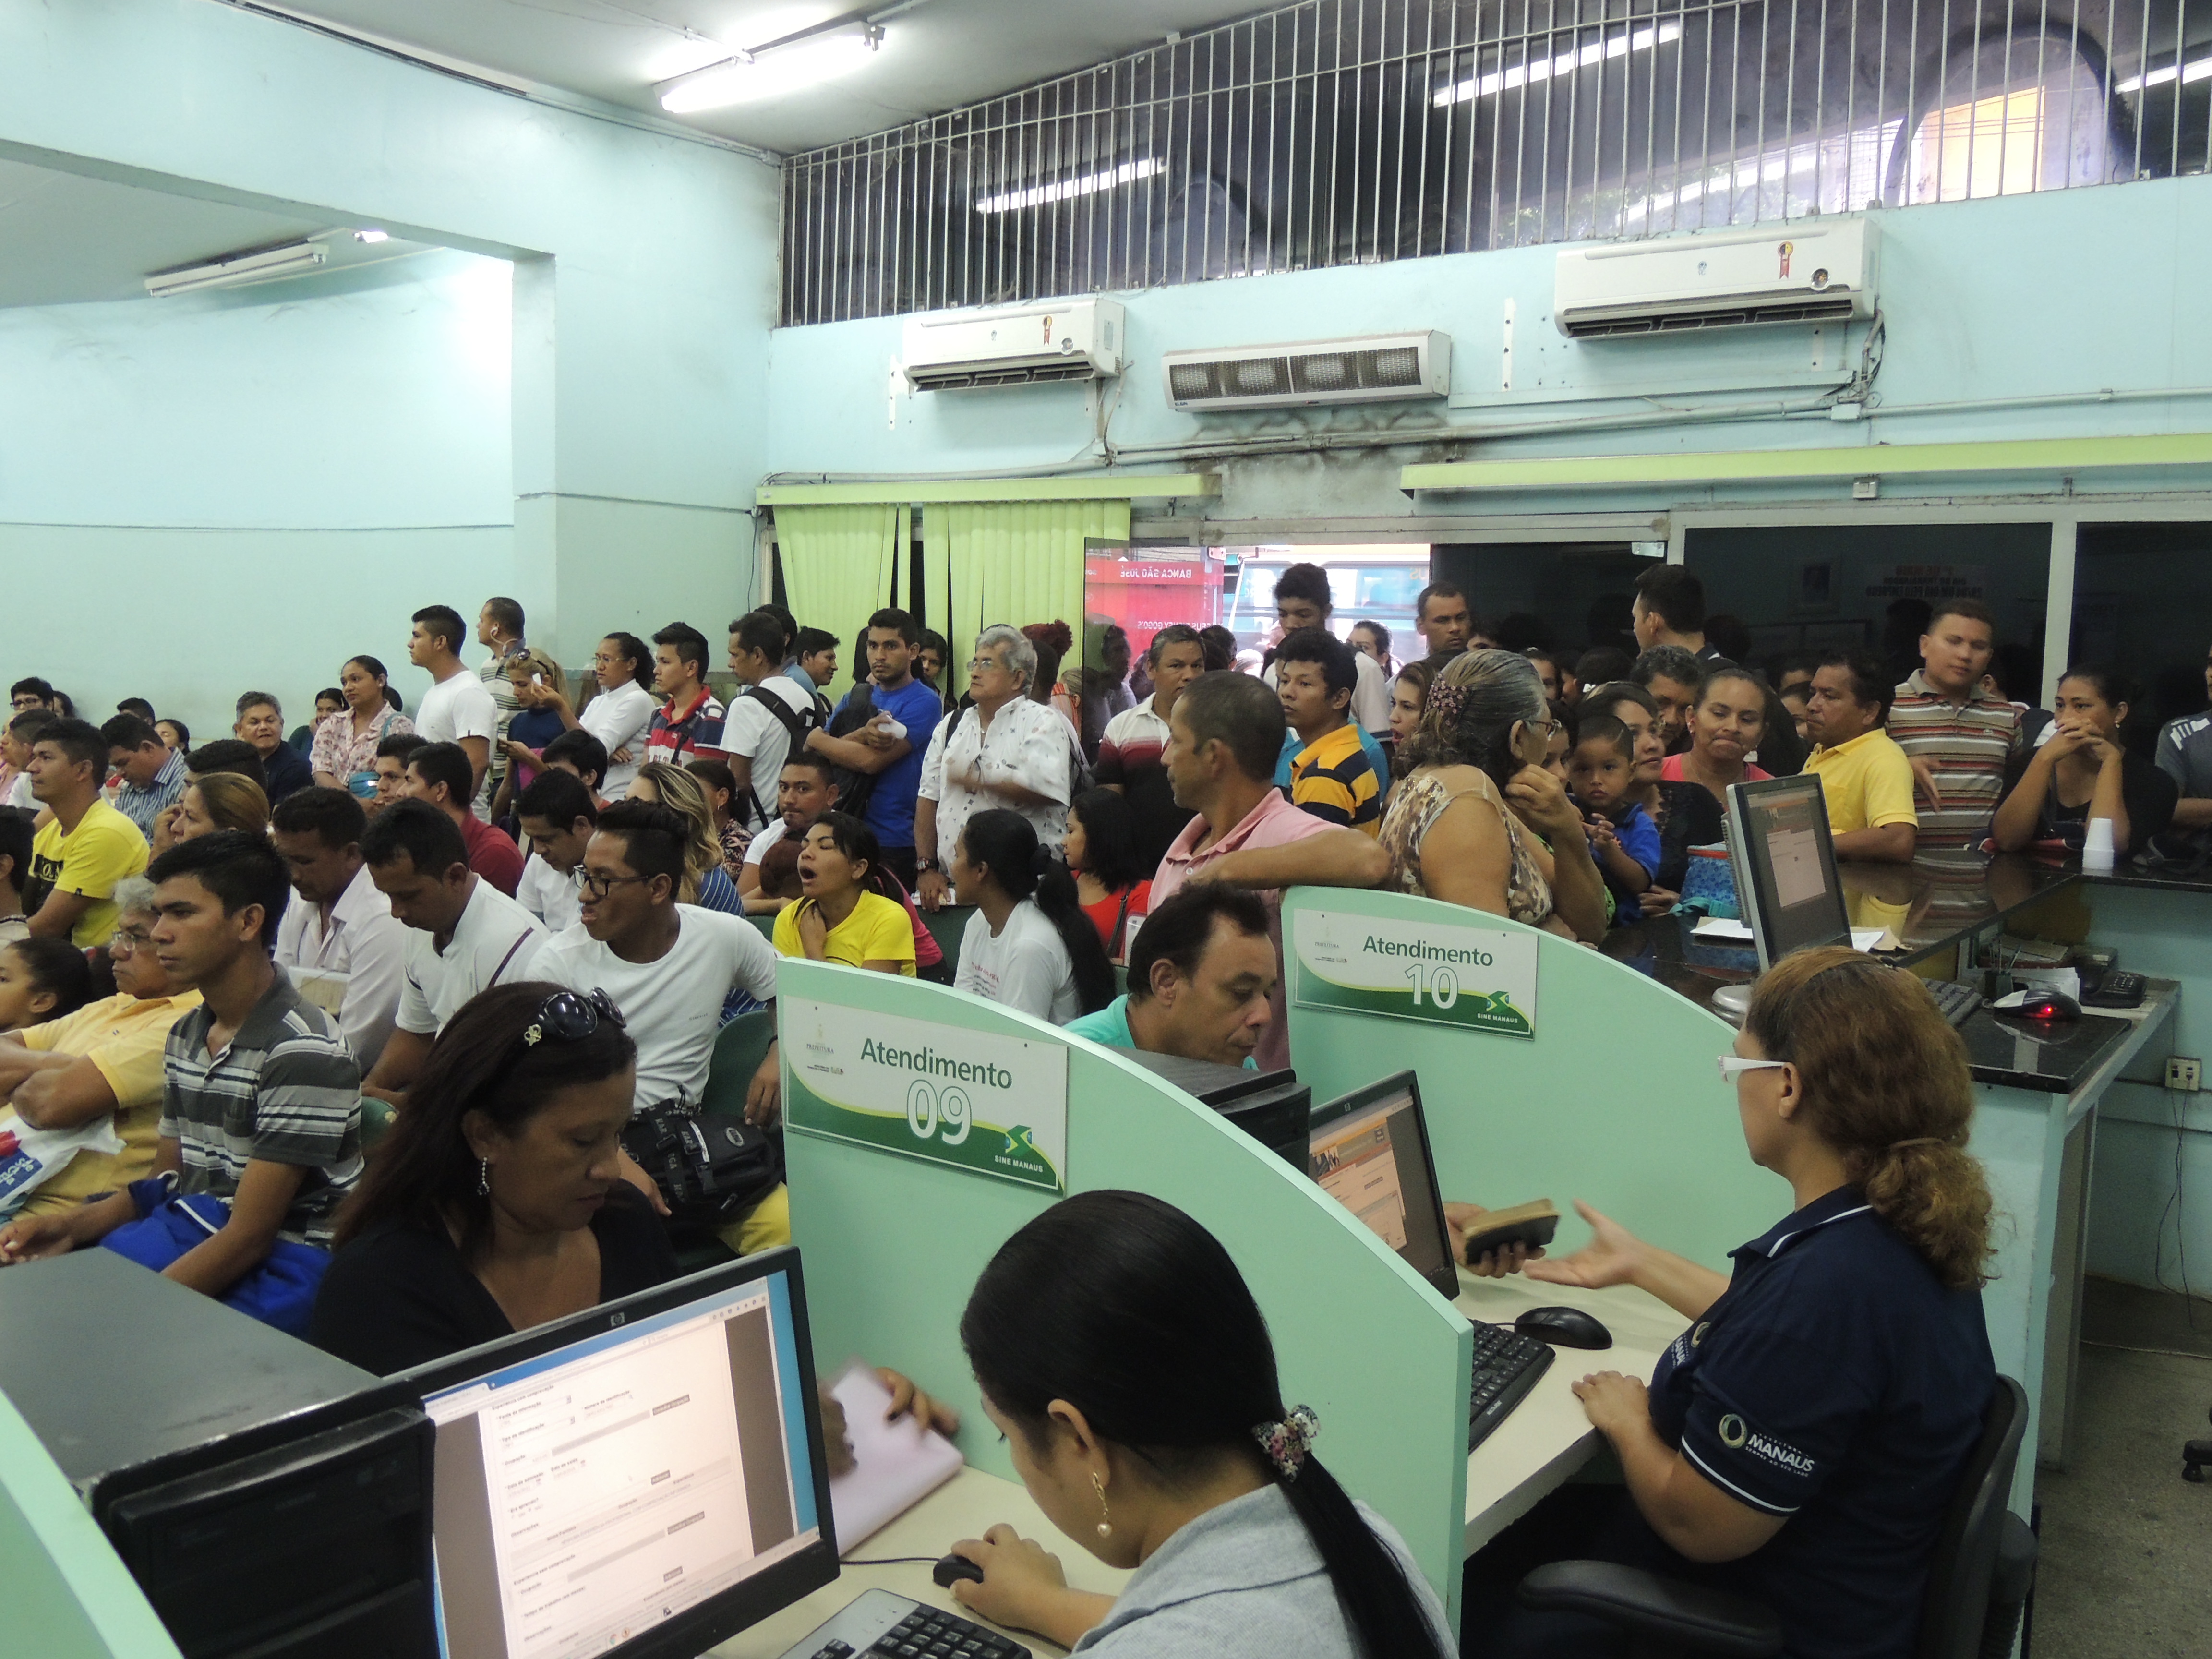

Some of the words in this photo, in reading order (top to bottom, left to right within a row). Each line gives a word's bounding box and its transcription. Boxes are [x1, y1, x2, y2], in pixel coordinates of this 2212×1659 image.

[1363, 935, 1493, 966] Atendimento
[1405, 963, 1459, 1009] 10
[1492, 1015, 1518, 1023] MANAUS
[860, 1037, 1012, 1089] Atendimento
[907, 1079, 972, 1145] 09
[995, 1155, 1011, 1166] SINE
[1013, 1159, 1043, 1173] MANAUS
[1747, 1434, 1815, 1472] MANAUS
